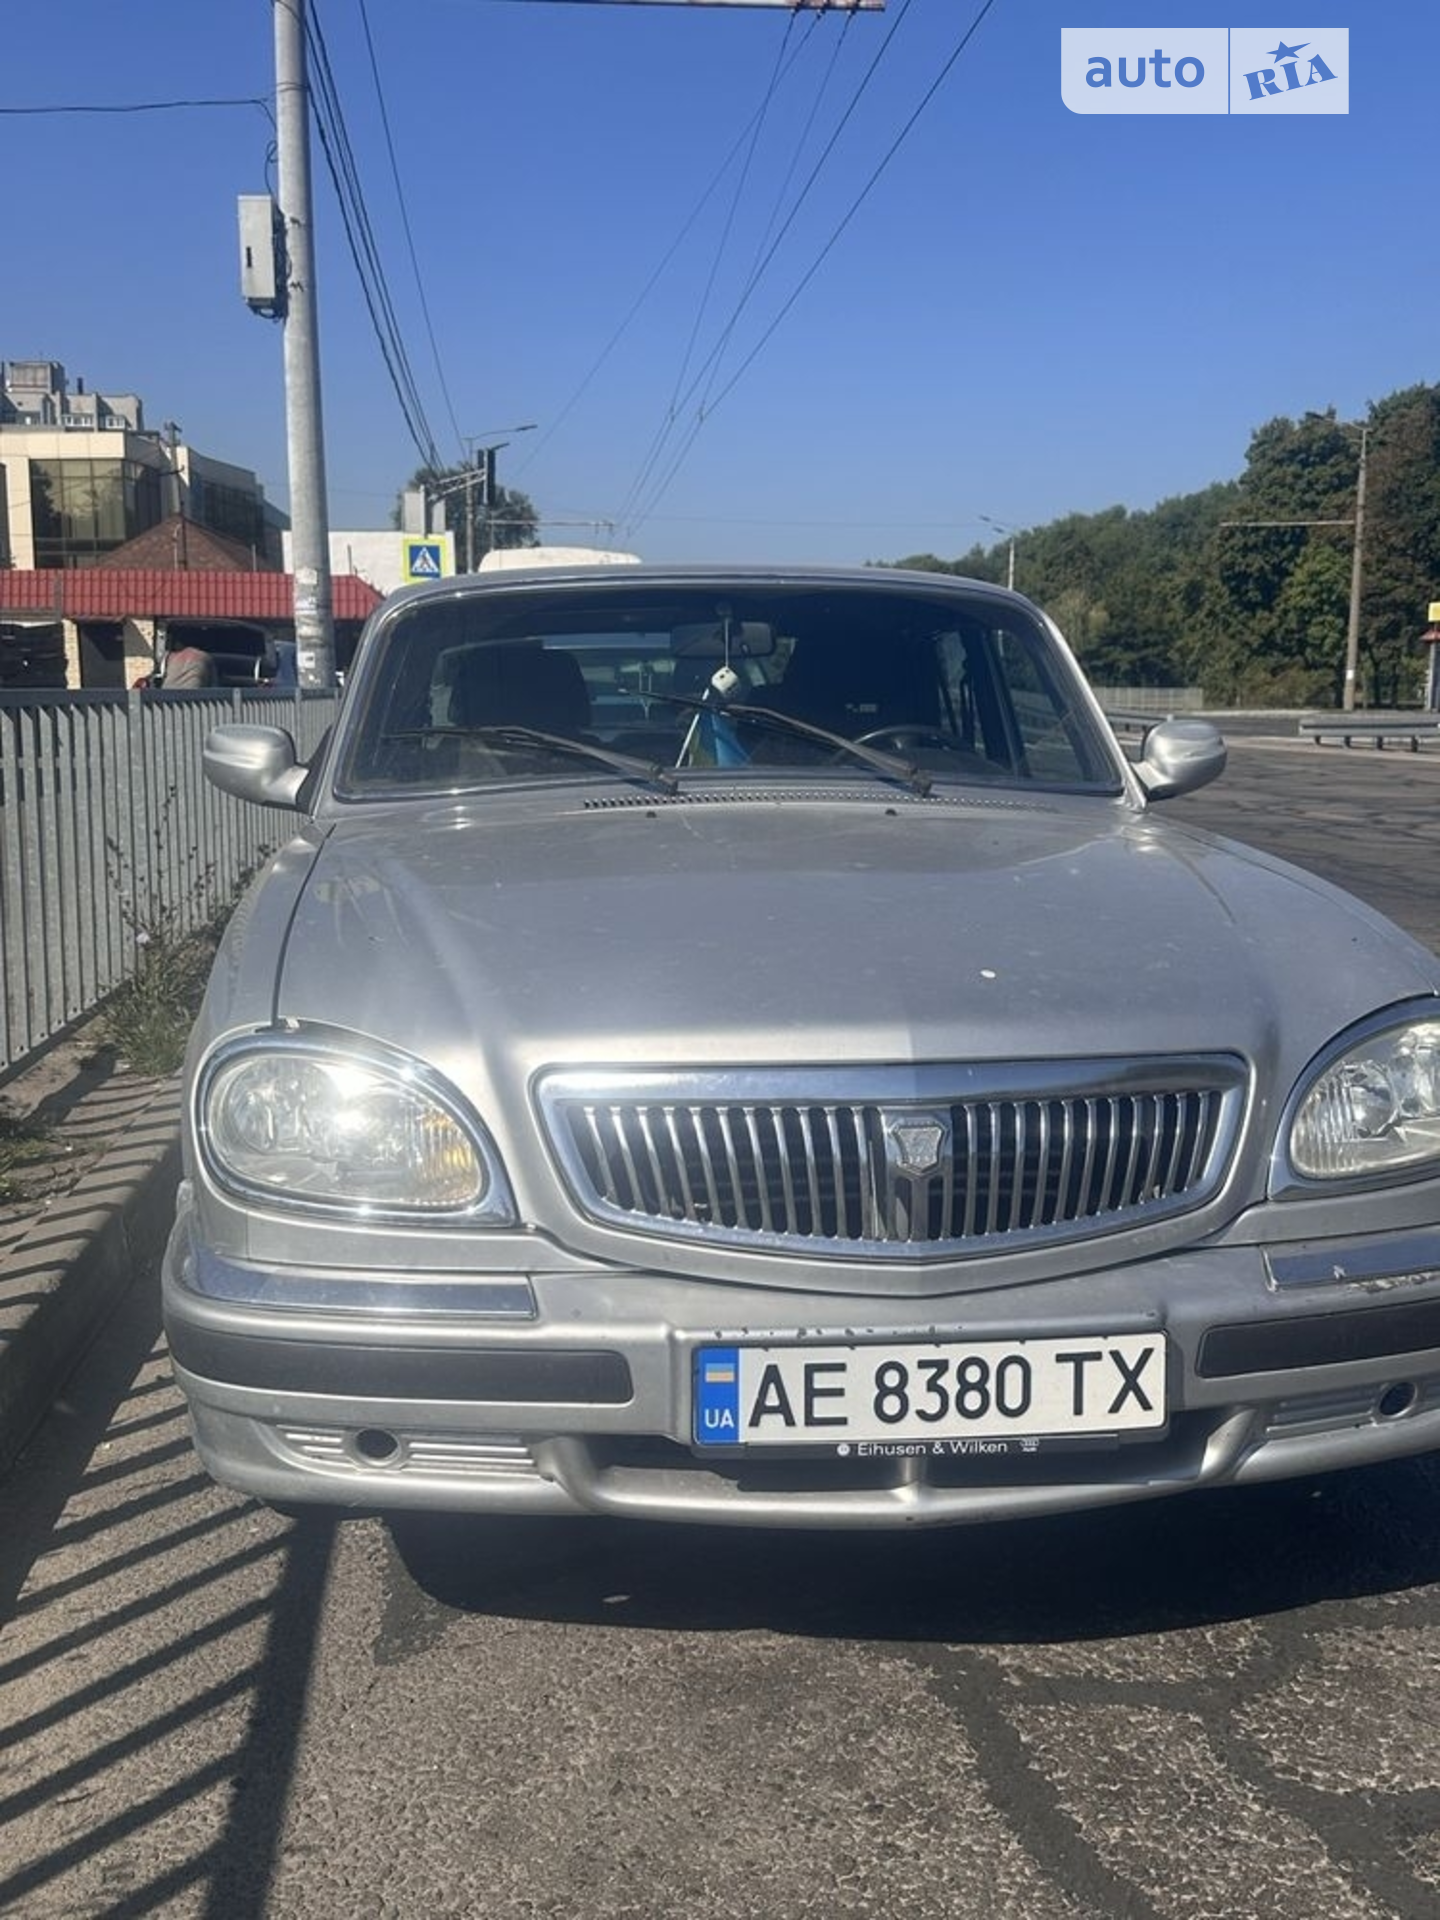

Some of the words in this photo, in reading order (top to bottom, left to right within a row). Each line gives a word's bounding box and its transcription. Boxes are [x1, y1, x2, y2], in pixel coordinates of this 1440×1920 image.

[748, 1362, 848, 1427] AE
[873, 1355, 1032, 1424] 8380
[1055, 1347, 1155, 1416] TX
[704, 1408, 735, 1428] UA
[932, 1442, 945, 1454] &
[950, 1439, 1008, 1454] Wilken
